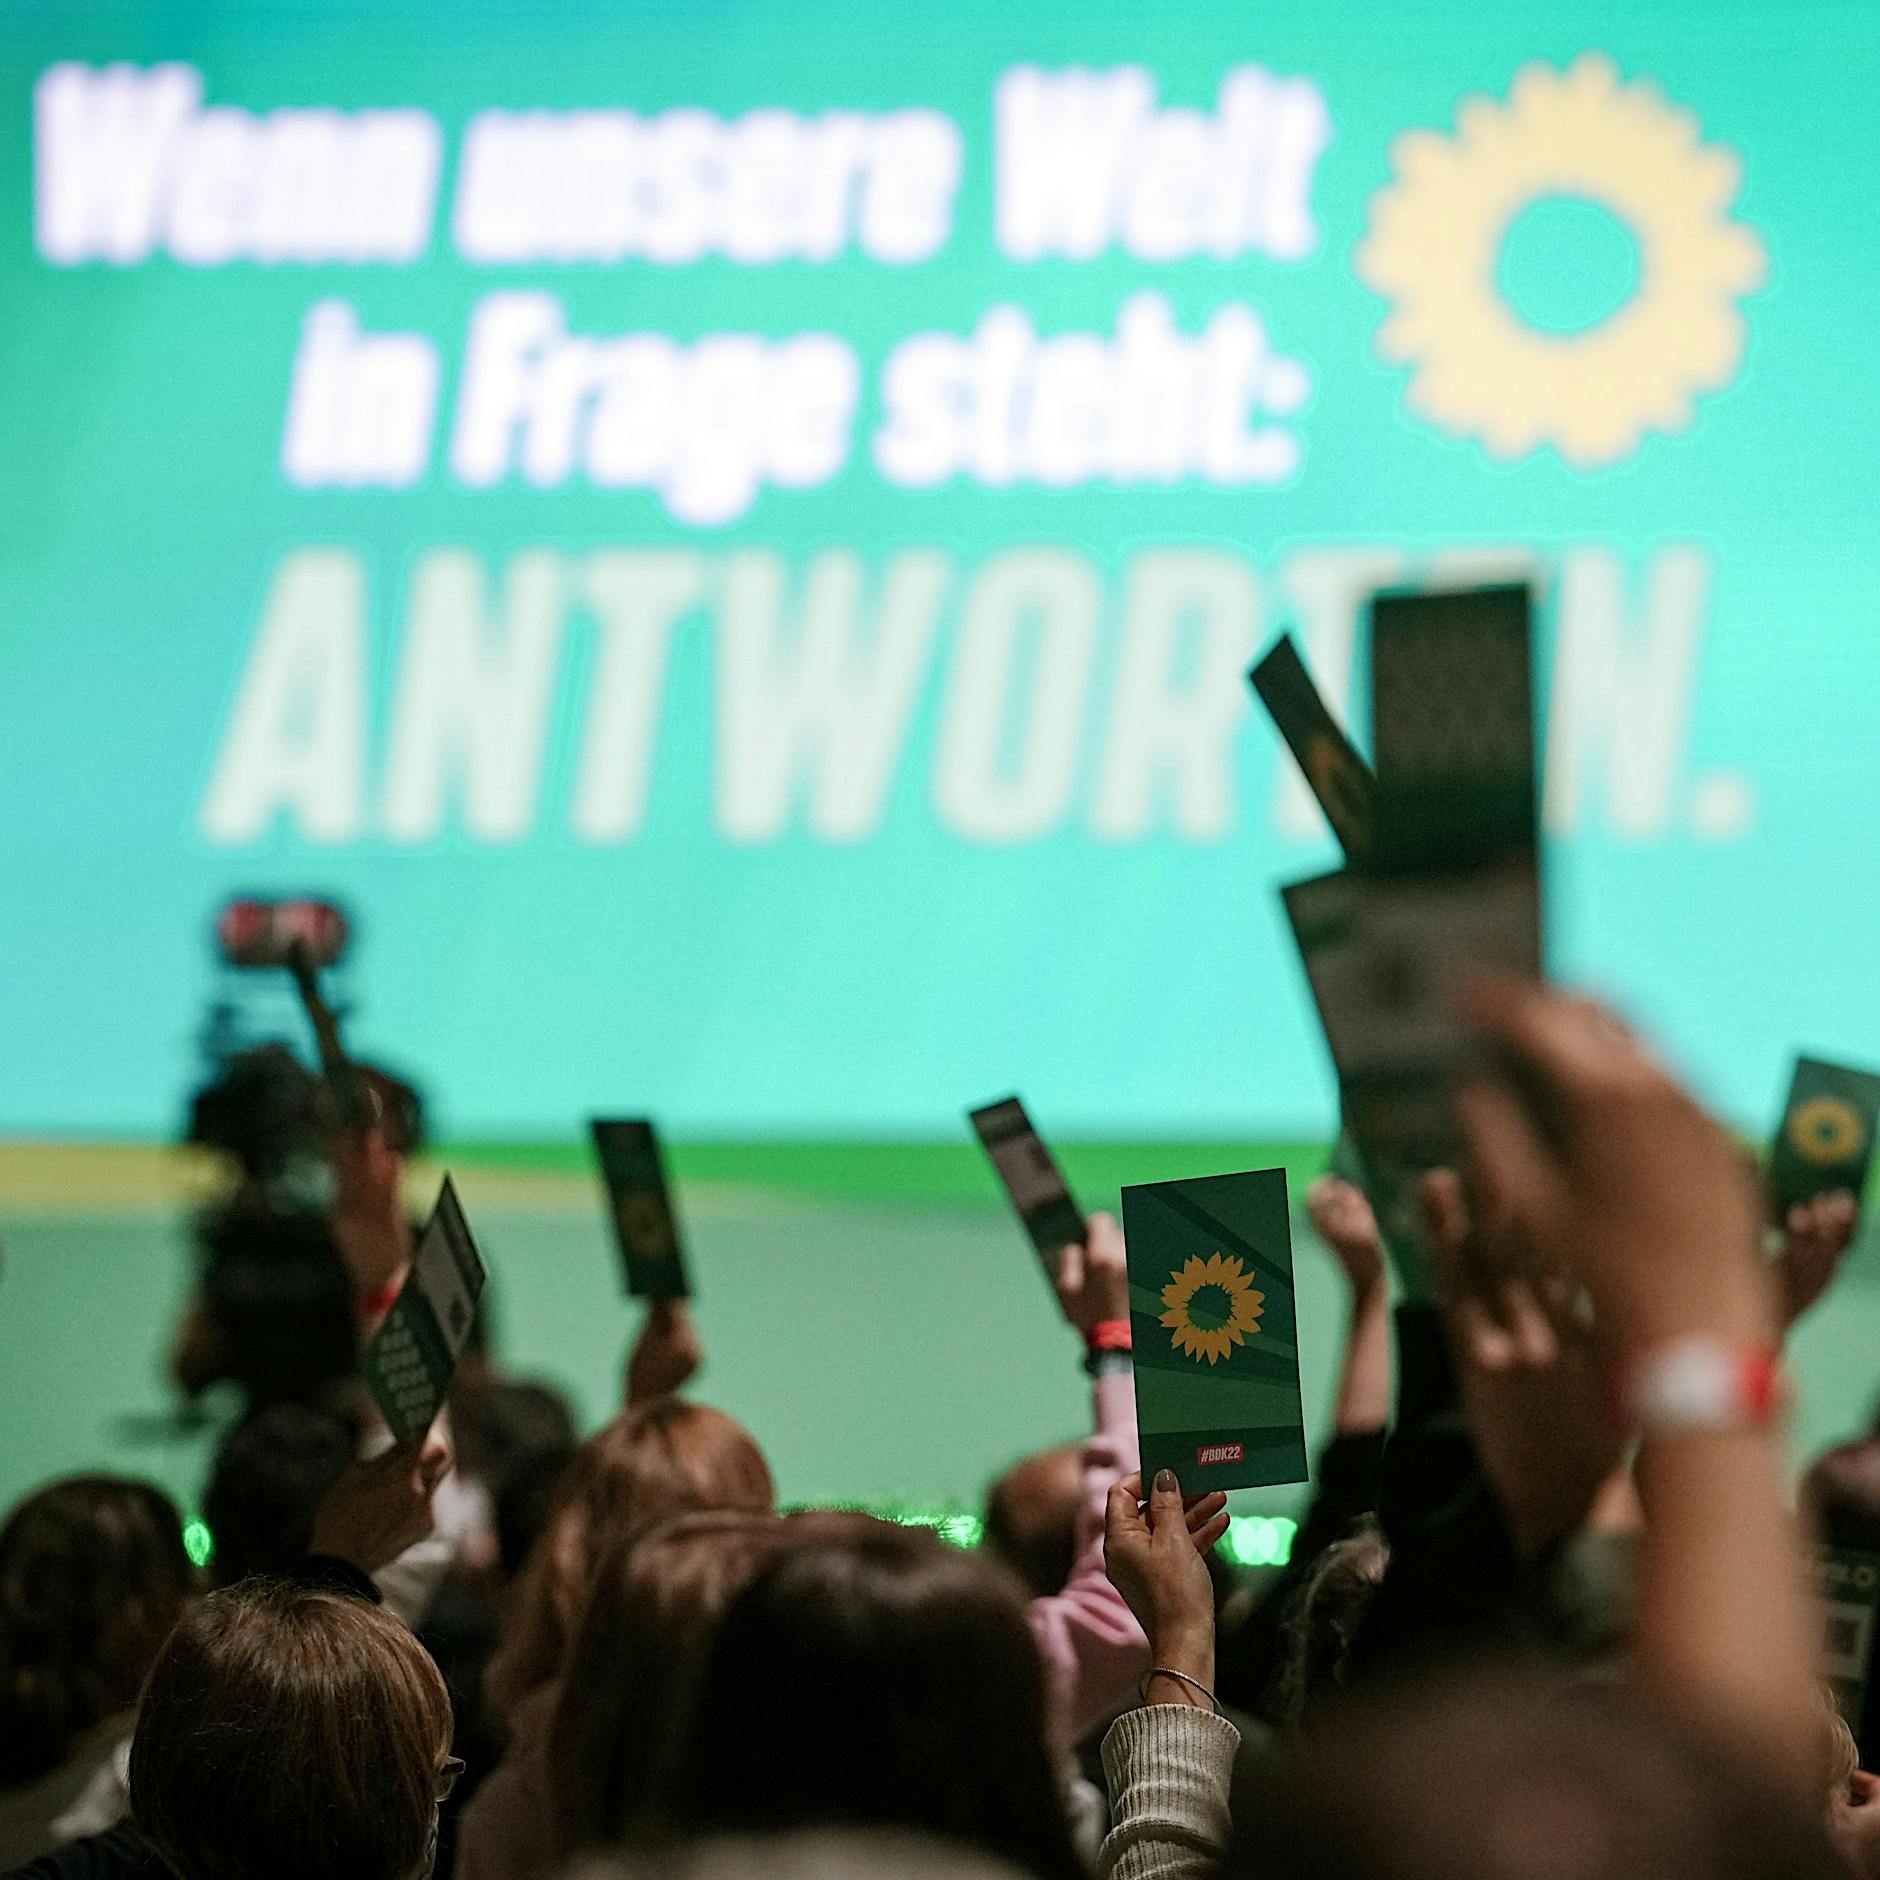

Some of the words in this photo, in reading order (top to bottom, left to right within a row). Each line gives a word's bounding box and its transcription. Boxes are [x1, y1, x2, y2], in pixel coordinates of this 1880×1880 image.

[38, 65, 441, 264] Wenn
[453, 109, 963, 265] unsere
[993, 65, 1330, 264] Welt
[449, 290, 862, 526] Frage
[871, 288, 1312, 488] steht:
[200, 545, 1758, 846] ANTWORTN.
[1201, 1446, 1241, 1462] #BDK22
